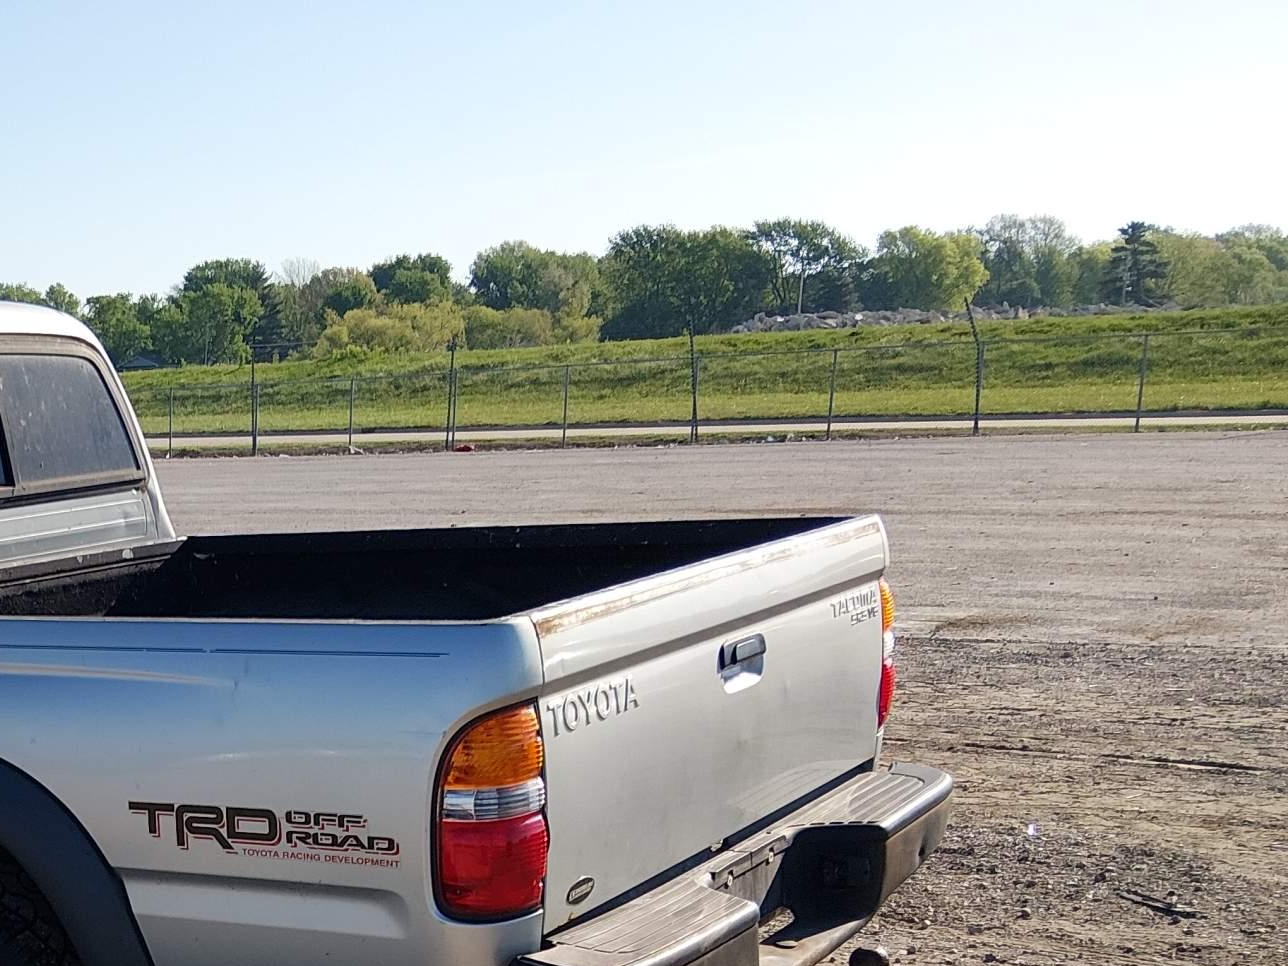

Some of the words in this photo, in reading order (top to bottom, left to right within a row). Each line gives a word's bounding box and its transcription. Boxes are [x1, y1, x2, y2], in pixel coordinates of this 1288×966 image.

[546, 677, 640, 737] TOYOTA
[128, 800, 282, 854] TRD
[285, 810, 368, 832] OFF
[285, 831, 400, 856] ROAD
[241, 848, 280, 859] TOYOTA
[282, 851, 321, 862] RACING
[324, 854, 401, 869] DEVELOPMENT
